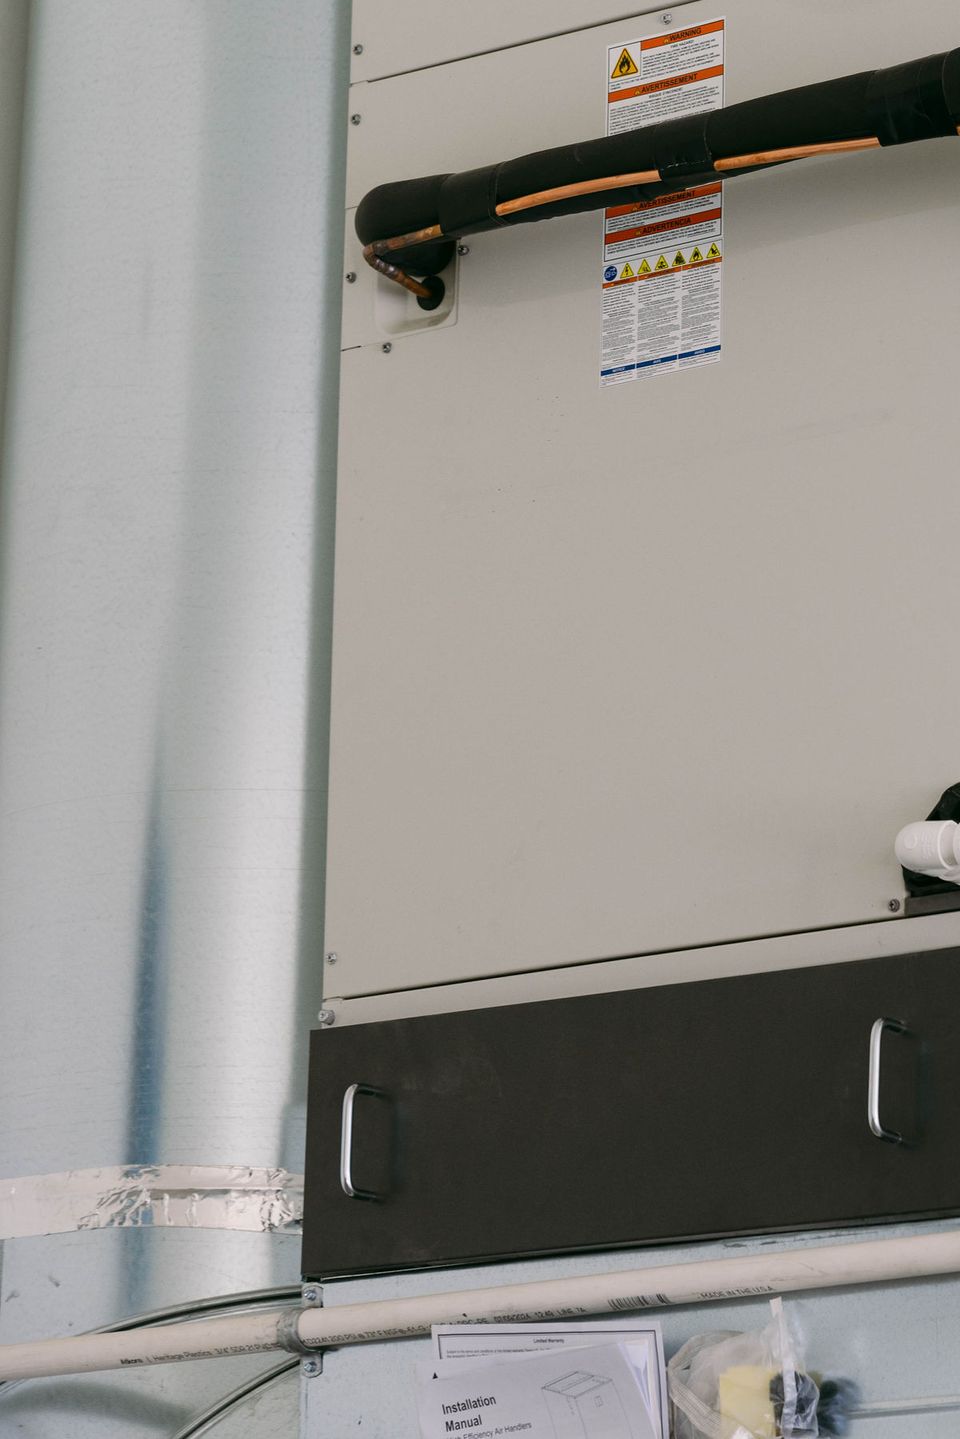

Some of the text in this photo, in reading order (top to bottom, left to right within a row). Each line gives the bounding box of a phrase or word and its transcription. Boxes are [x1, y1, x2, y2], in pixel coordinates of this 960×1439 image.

[670, 28, 701, 41] WARNING
[642, 74, 698, 93] AVERTISSEMENT
[639, 190, 695, 208] AVERTISSEMENT
[643, 217, 691, 234] ADVERTENCIA
[700, 1291, 724, 1300] MADE
[442, 1395, 497, 1415] Installation
[446, 1414, 483, 1433] Manual
[495, 1427, 504, 1435] Air
[504, 1422, 532, 1432] Handlers
